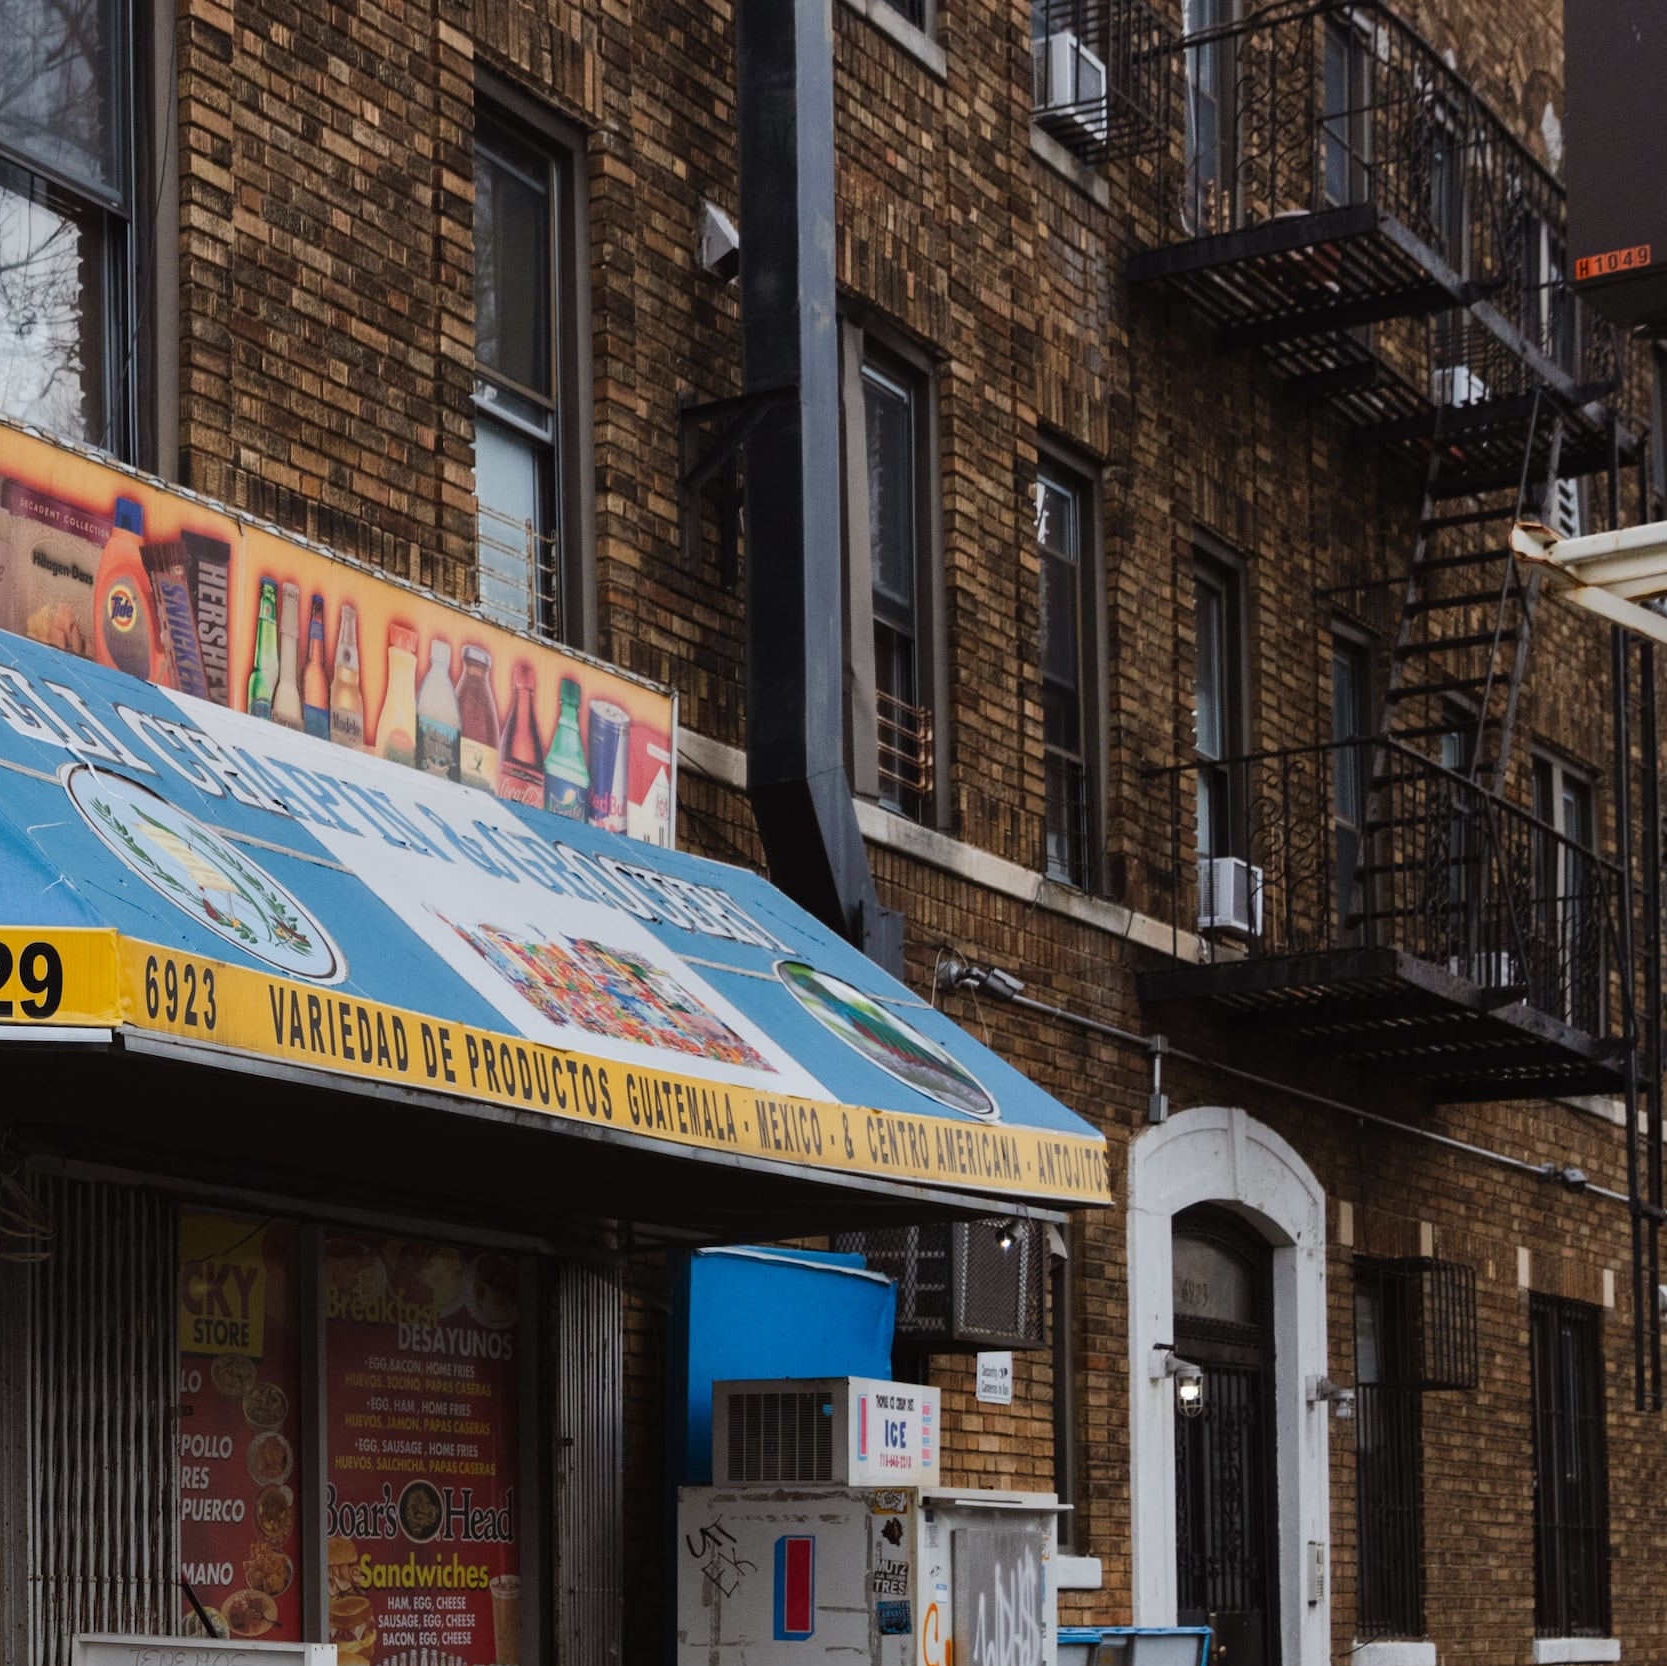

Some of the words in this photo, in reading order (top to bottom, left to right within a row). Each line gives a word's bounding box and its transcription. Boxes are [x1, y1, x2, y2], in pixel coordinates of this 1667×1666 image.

[1574, 244, 1651, 280] H1049
[20, 498, 61, 521] DECADENT
[111, 595, 134, 619] Tide
[333, 712, 360, 737] Modelo
[145, 954, 218, 1031] 6923
[268, 983, 409, 1073] VARIEDAD
[421, 1020, 456, 1084] DE
[467, 1034, 612, 1122] PRODUCTOS
[626, 1071, 736, 1144] GUATEMALA
[756, 1097, 823, 1155] MEXICO
[842, 1111, 855, 1147] &
[866, 1116, 931, 1171] CENTRO
[935, 1130, 1020, 1181] AMERICANA
[1036, 1140, 1110, 1193] ANTOJITOS
[325, 1284, 440, 1328] Breakfast
[193, 1318, 249, 1348] STORE
[398, 1323, 514, 1361] DESAYUNOS
[426, 1360, 453, 1376] HOME
[453, 1362, 475, 1378] FRIES
[425, 1379, 453, 1394] PAPAS
[454, 1381, 492, 1397] CASERAS
[421, 1402, 447, 1416] HOME
[448, 1402, 471, 1417] FRIES
[424, 1418, 452, 1433] PAPAS
[453, 1420, 490, 1436] CASERAS
[884, 1419, 907, 1449] ICE
[180, 1434, 234, 1459] POLLO
[429, 1443, 456, 1457] HOME
[456, 1444, 478, 1458] FRIES
[180, 1466, 210, 1490] RES
[429, 1459, 457, 1474] PAPAS
[458, 1460, 496, 1477] CASERAS
[181, 1498, 245, 1523] PUERCO
[443, 1486, 516, 1543] Head
[359, 1551, 490, 1590] Sandwiches
[876, 1559, 908, 1575] MUTZ
[874, 1579, 906, 1595] TRES
[387, 1596, 412, 1611] HAM,
[436, 1596, 466, 1610] CHEESE
[378, 1614, 422, 1629] SAUSAGE,
[446, 1614, 475, 1628] CHEESE
[382, 1632, 417, 1647] BACON,
[442, 1632, 472, 1645] CHEESE
